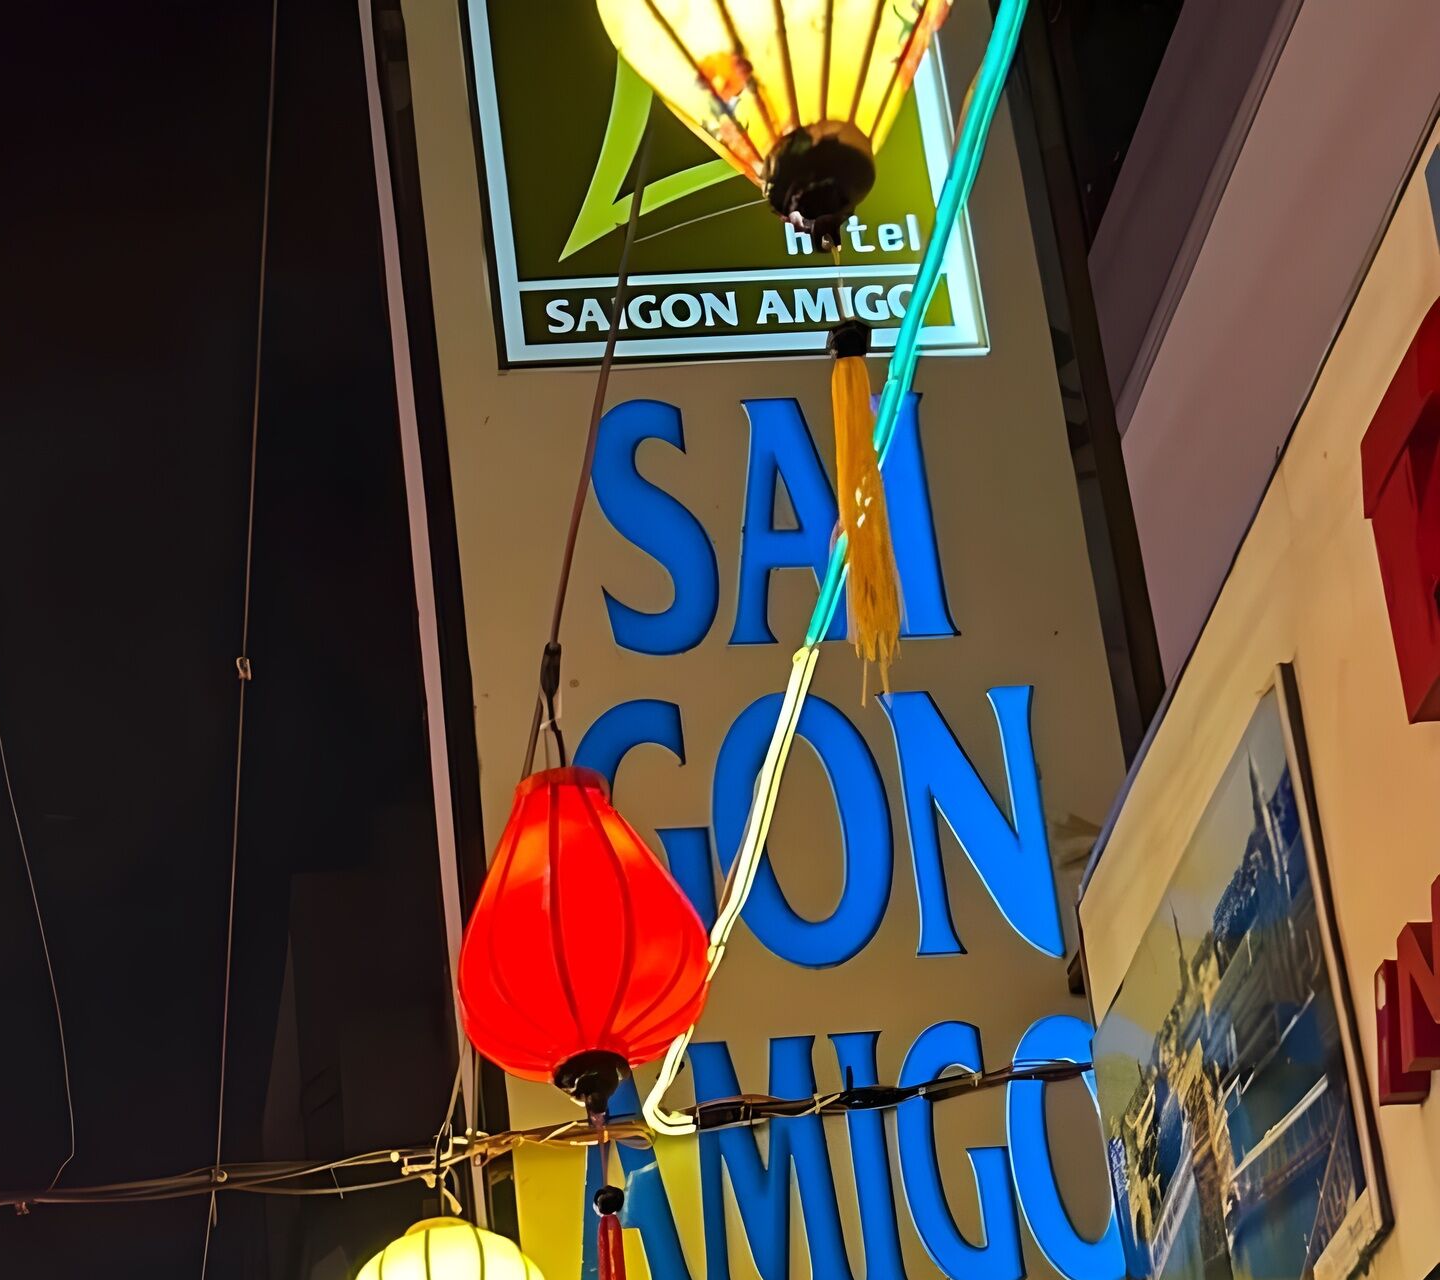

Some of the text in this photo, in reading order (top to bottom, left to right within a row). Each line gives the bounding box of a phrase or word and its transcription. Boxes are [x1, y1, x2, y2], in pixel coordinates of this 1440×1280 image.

[785, 214, 921, 256] htel
[545, 291, 739, 334] SAIGON
[590, 391, 961, 656] SAI
